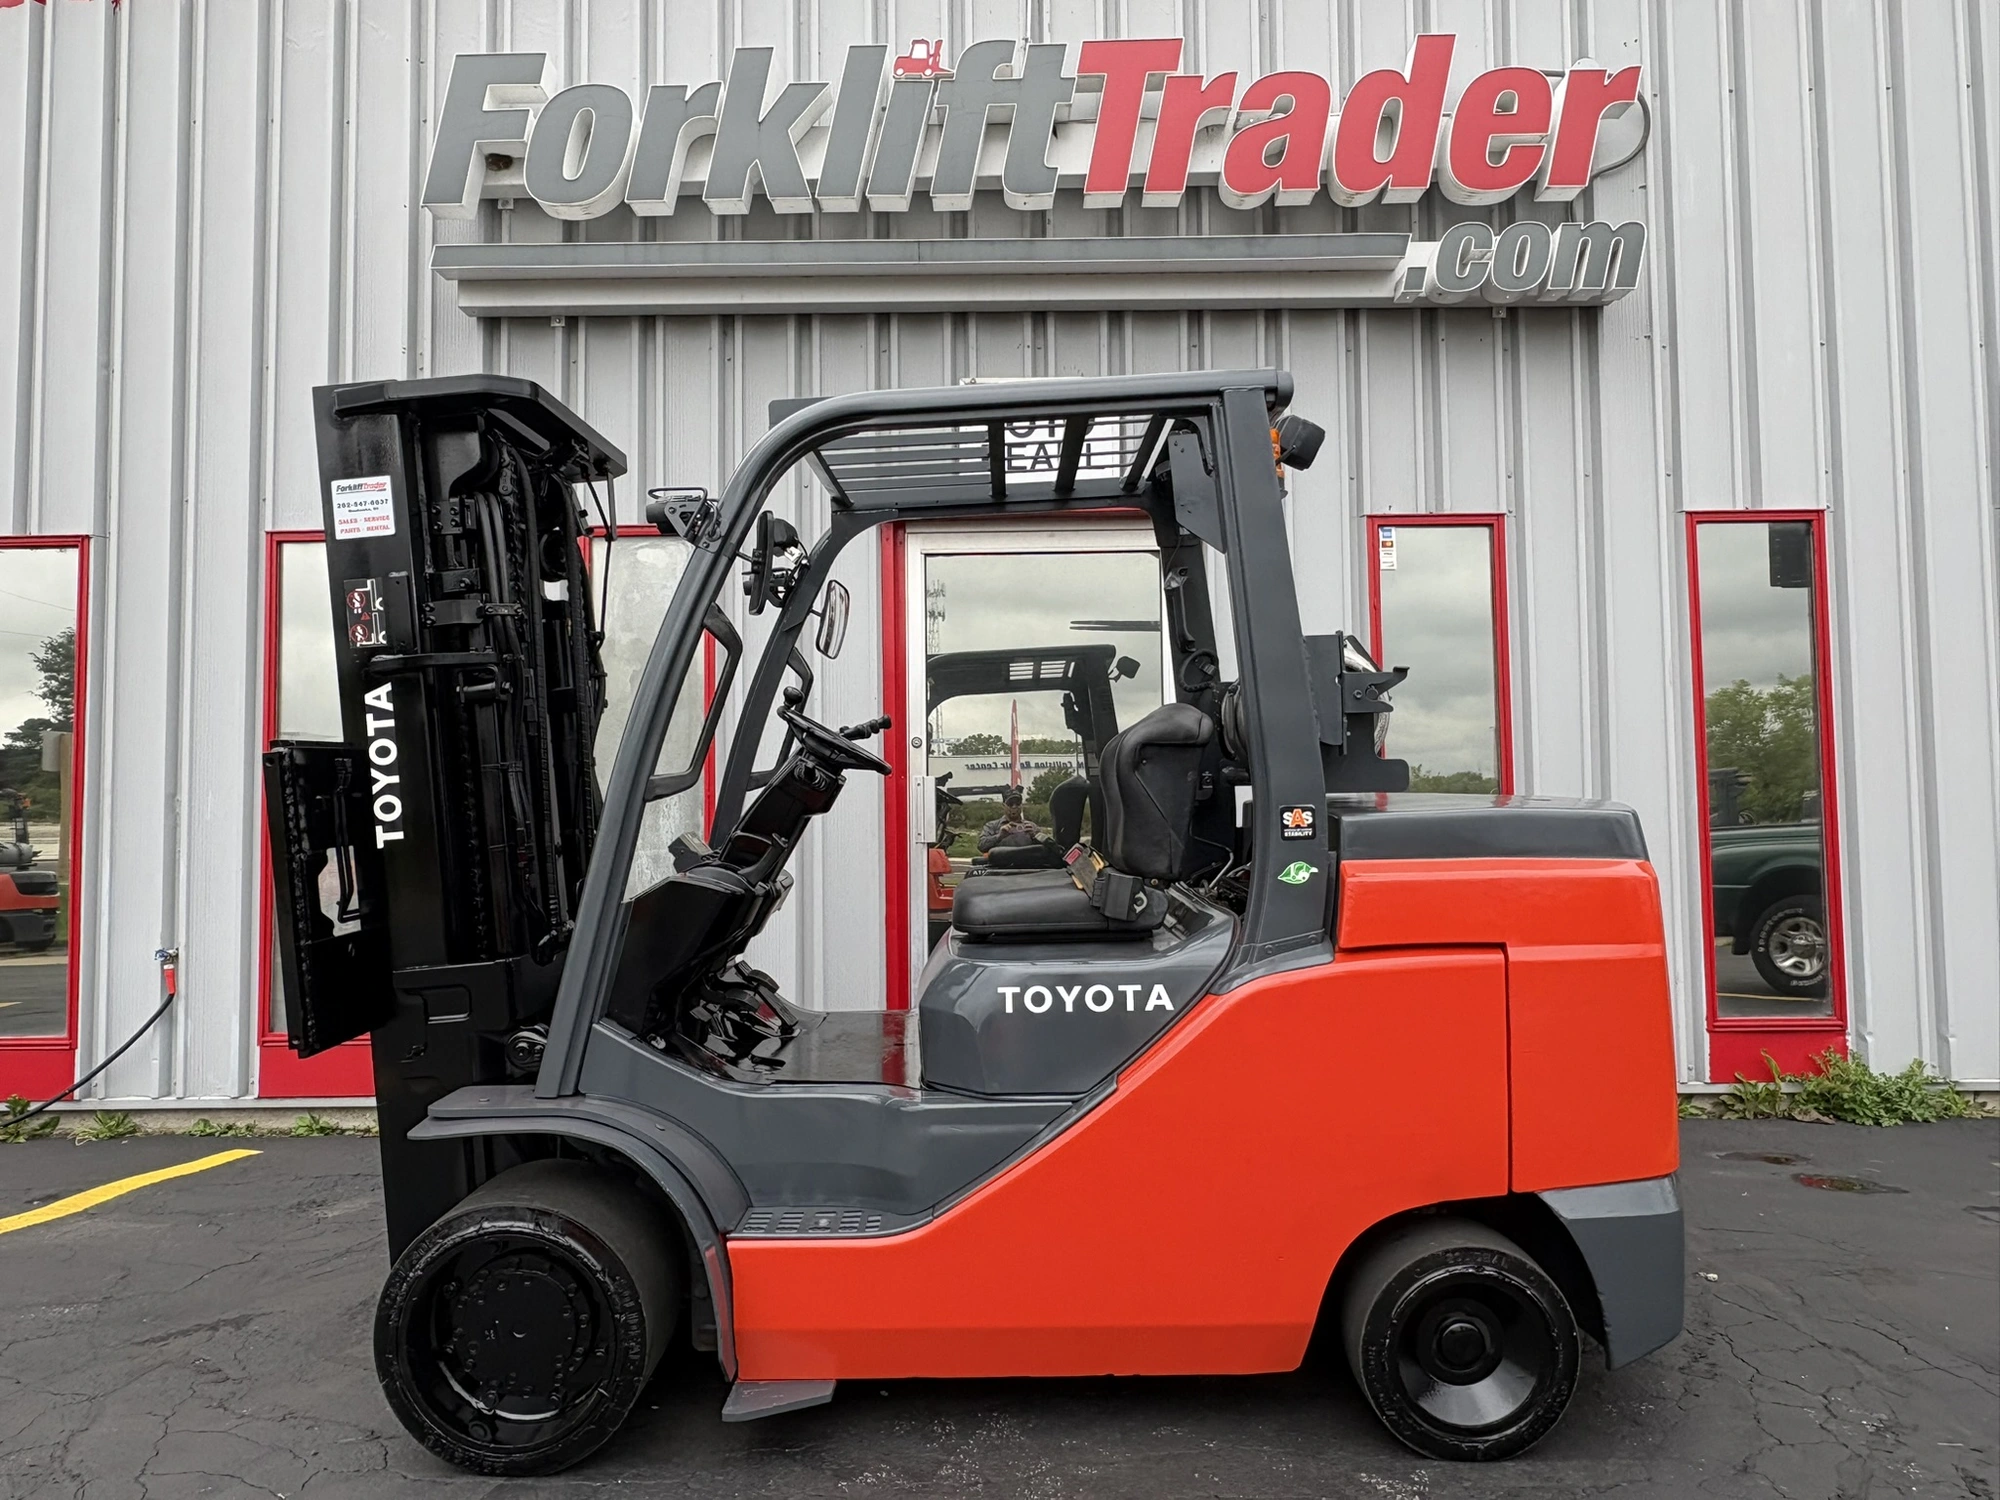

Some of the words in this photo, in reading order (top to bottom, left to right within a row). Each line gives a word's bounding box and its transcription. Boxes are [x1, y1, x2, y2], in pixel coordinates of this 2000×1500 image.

[421, 33, 1643, 208] ForkliftTrader
[1403, 221, 1647, 293] .com
[364, 681, 405, 850] TOYOTA
[1282, 808, 1313, 827] SAS
[997, 984, 1175, 1014] TOYOTA
